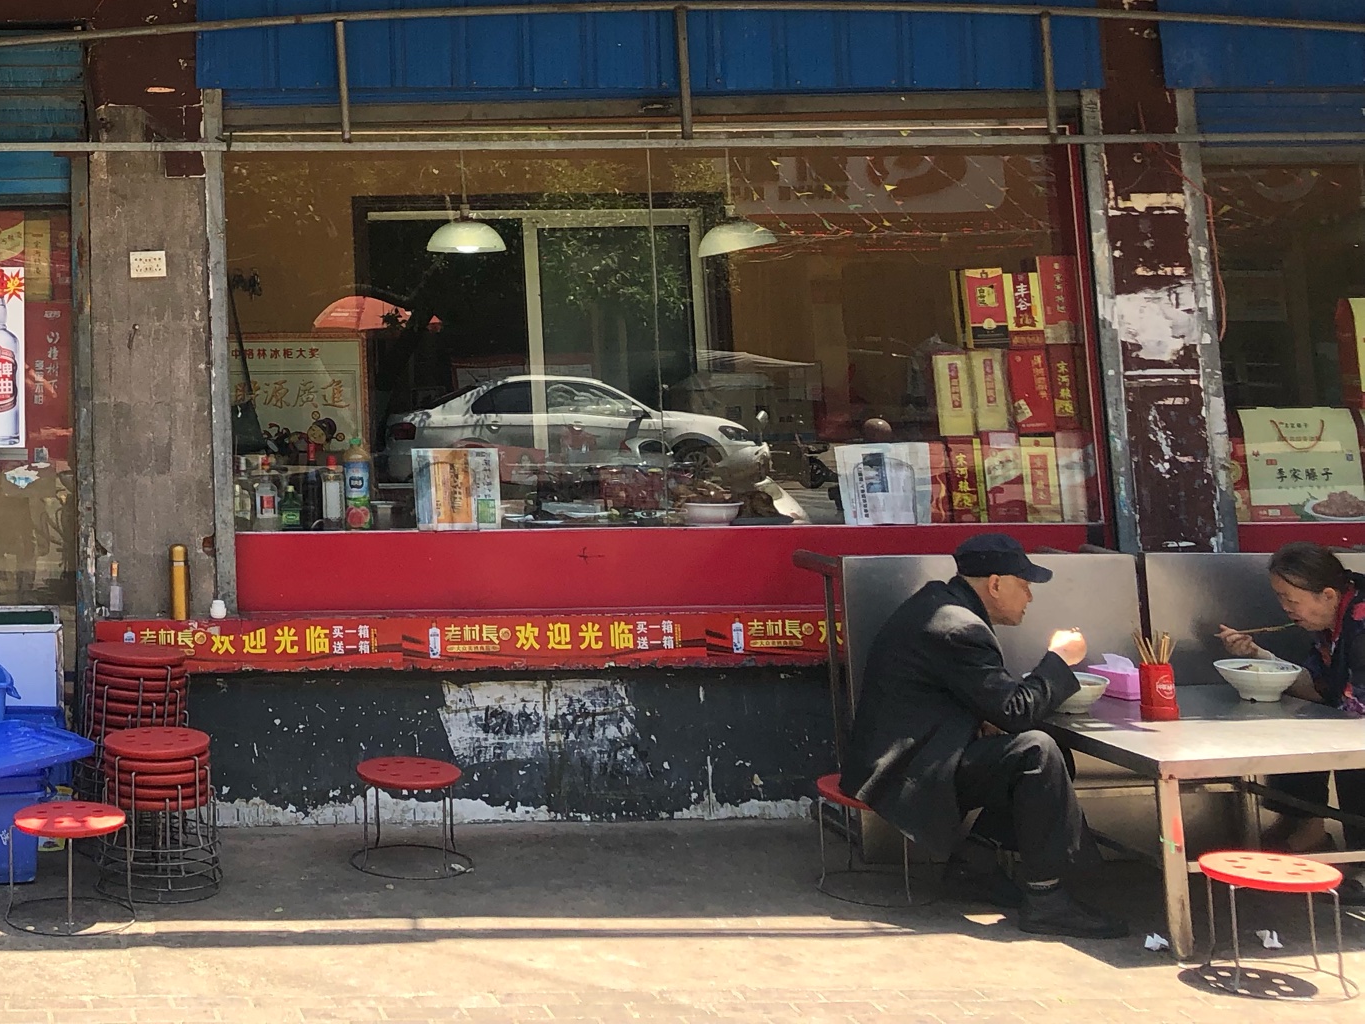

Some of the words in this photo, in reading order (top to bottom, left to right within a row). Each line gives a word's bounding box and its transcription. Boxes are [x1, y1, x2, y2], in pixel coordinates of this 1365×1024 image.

[332, 625, 370, 639] 买一箱
[636, 620, 674, 633] 买一箱
[211, 626, 330, 655] 欢迎光临
[515, 621, 634, 651] 欢迎光临
[636, 636, 674, 650] 送一箱
[332, 640, 370, 654] 送一箱
